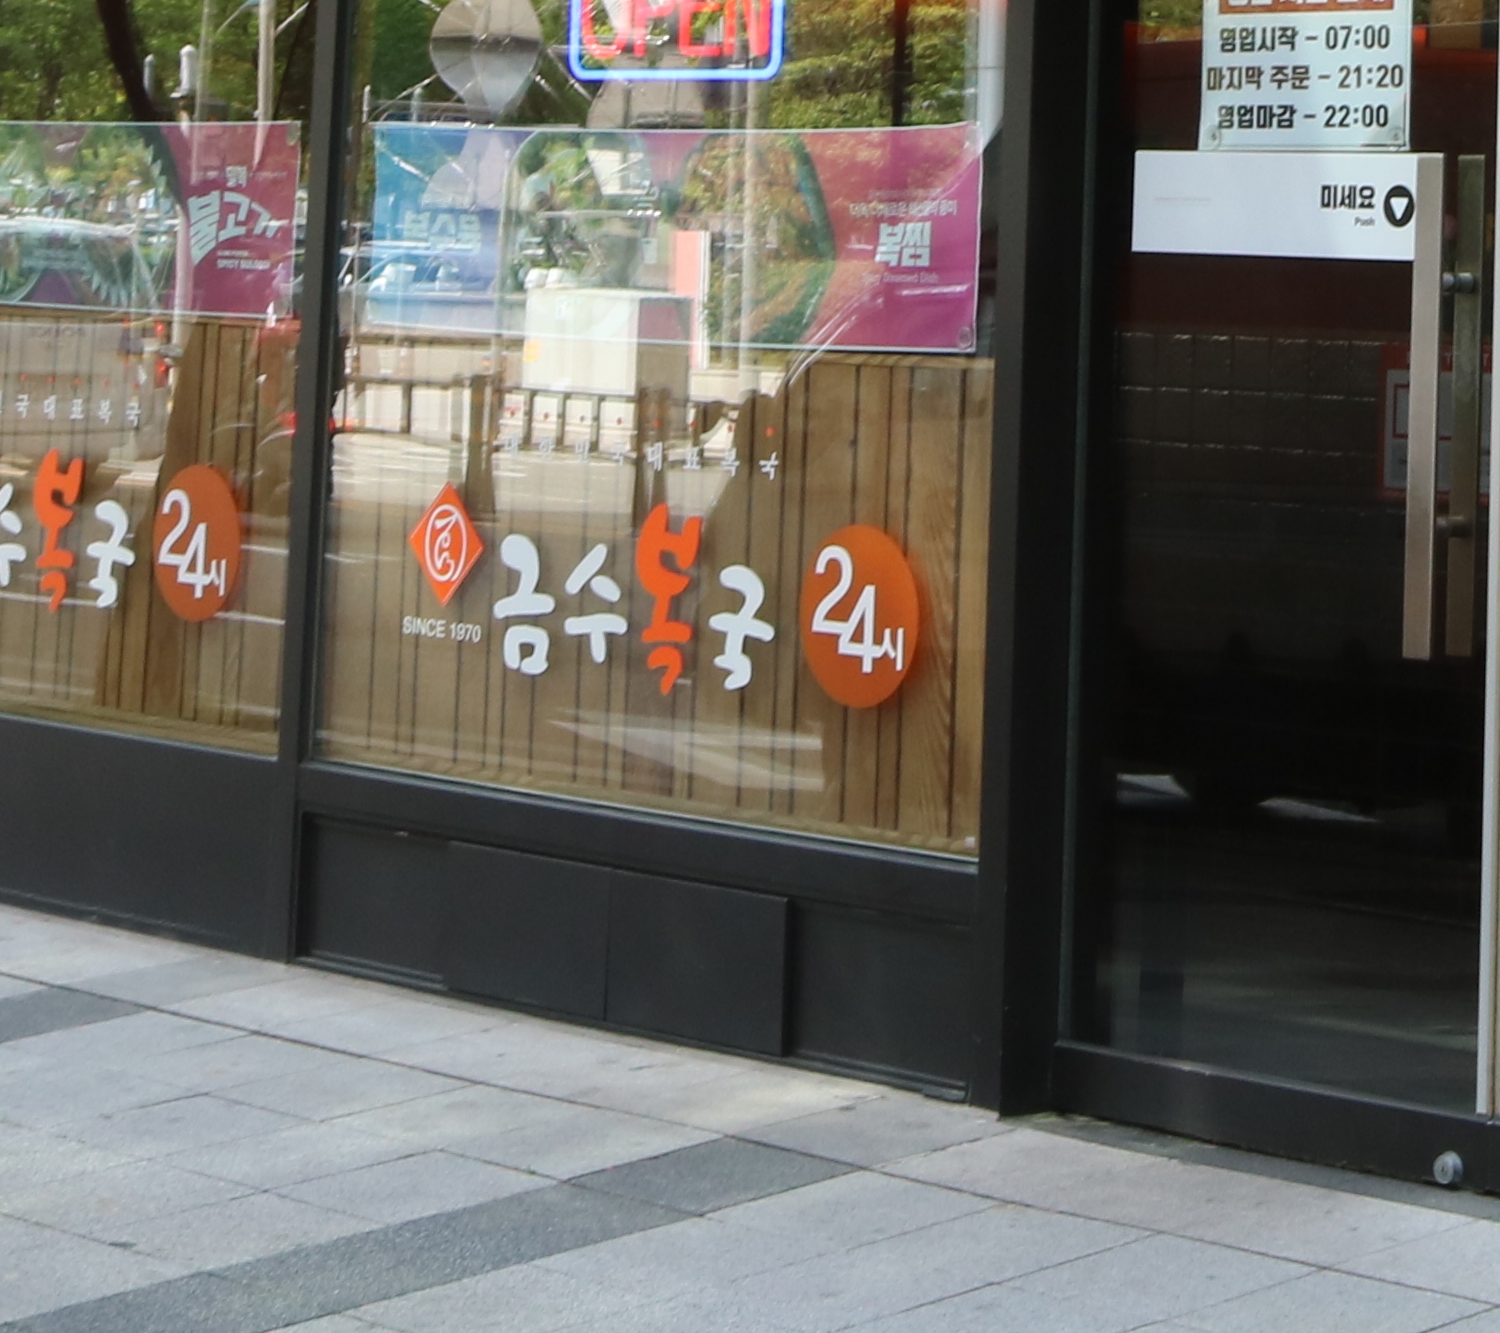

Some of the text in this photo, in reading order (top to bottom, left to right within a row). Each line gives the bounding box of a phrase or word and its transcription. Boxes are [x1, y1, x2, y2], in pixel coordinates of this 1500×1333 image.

[1220, 25, 1391, 53] 영업시작 07:00
[1207, 64, 1404, 91] 마지막 주문 21:20
[1217, 104, 1389, 130] 영업마감 22:00
[1320, 184, 1376, 211] 미세요
[1354, 216, 1376, 227] Push
[874, 220, 932, 267] 복찜
[157, 489, 228, 599] 24시
[493, 503, 775, 695] 금수복국
[811, 545, 904, 674] 24시
[402, 615, 482, 644] SINCE 1970
